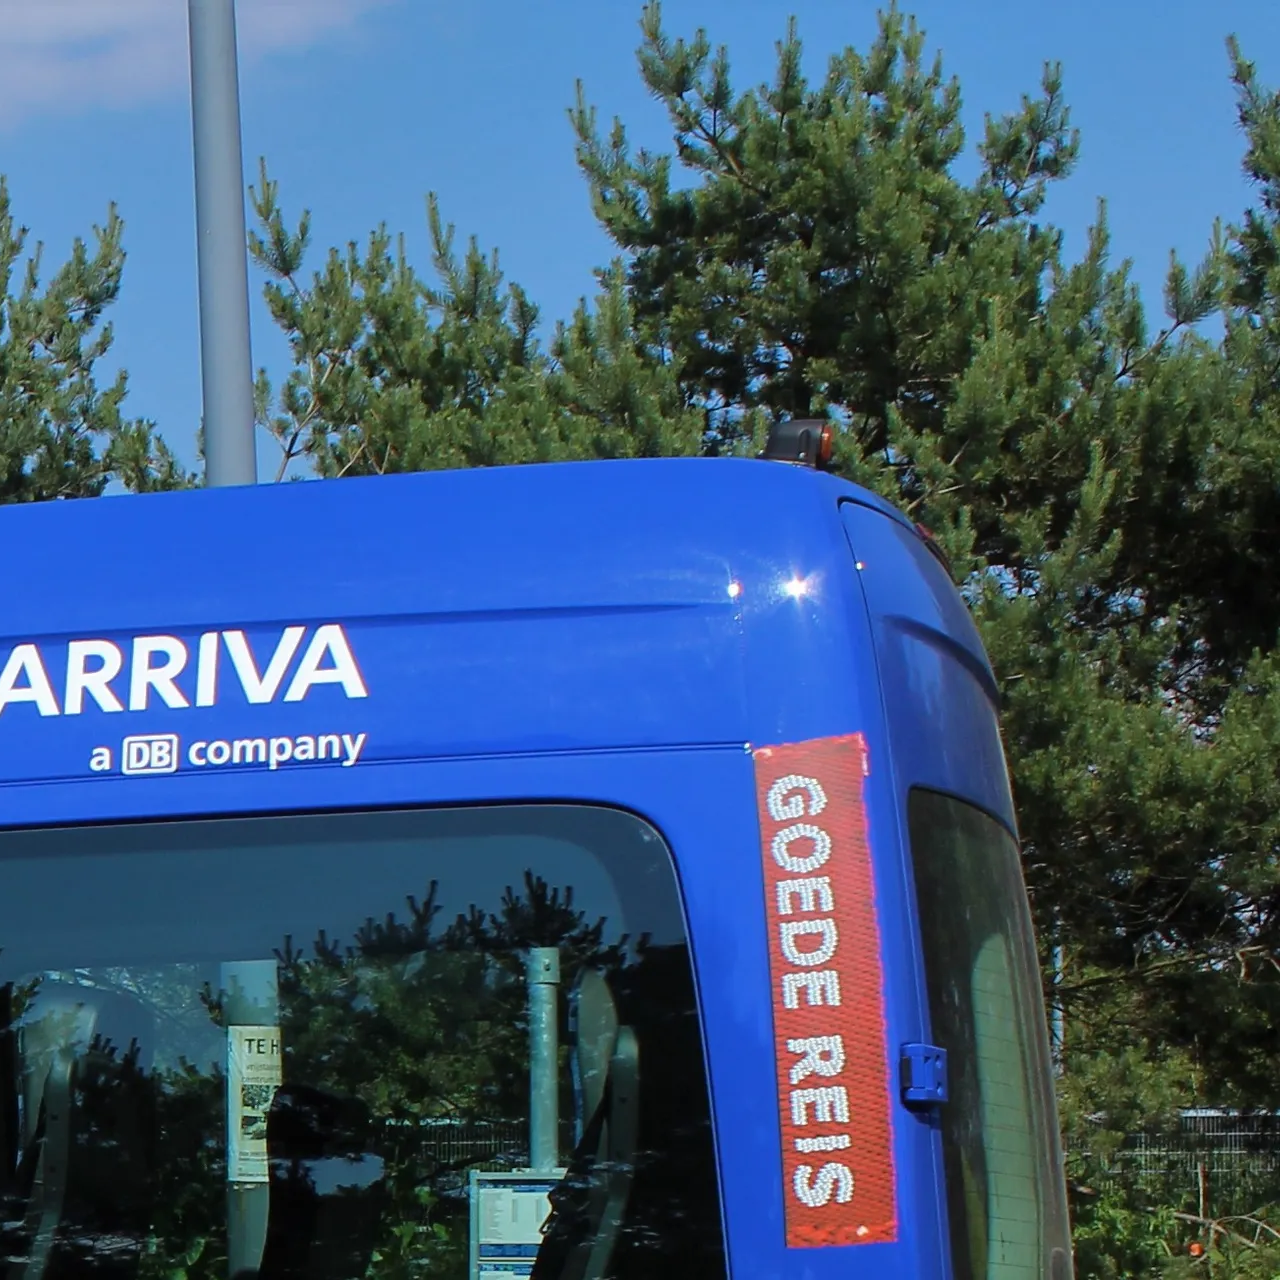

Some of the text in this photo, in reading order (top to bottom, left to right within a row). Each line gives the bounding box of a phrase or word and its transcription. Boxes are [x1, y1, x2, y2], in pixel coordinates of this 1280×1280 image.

[89, 733, 366, 772] a DB company
[766, 773, 855, 1208] GOEDE REIS
[244, 1038, 266, 1055] TE
